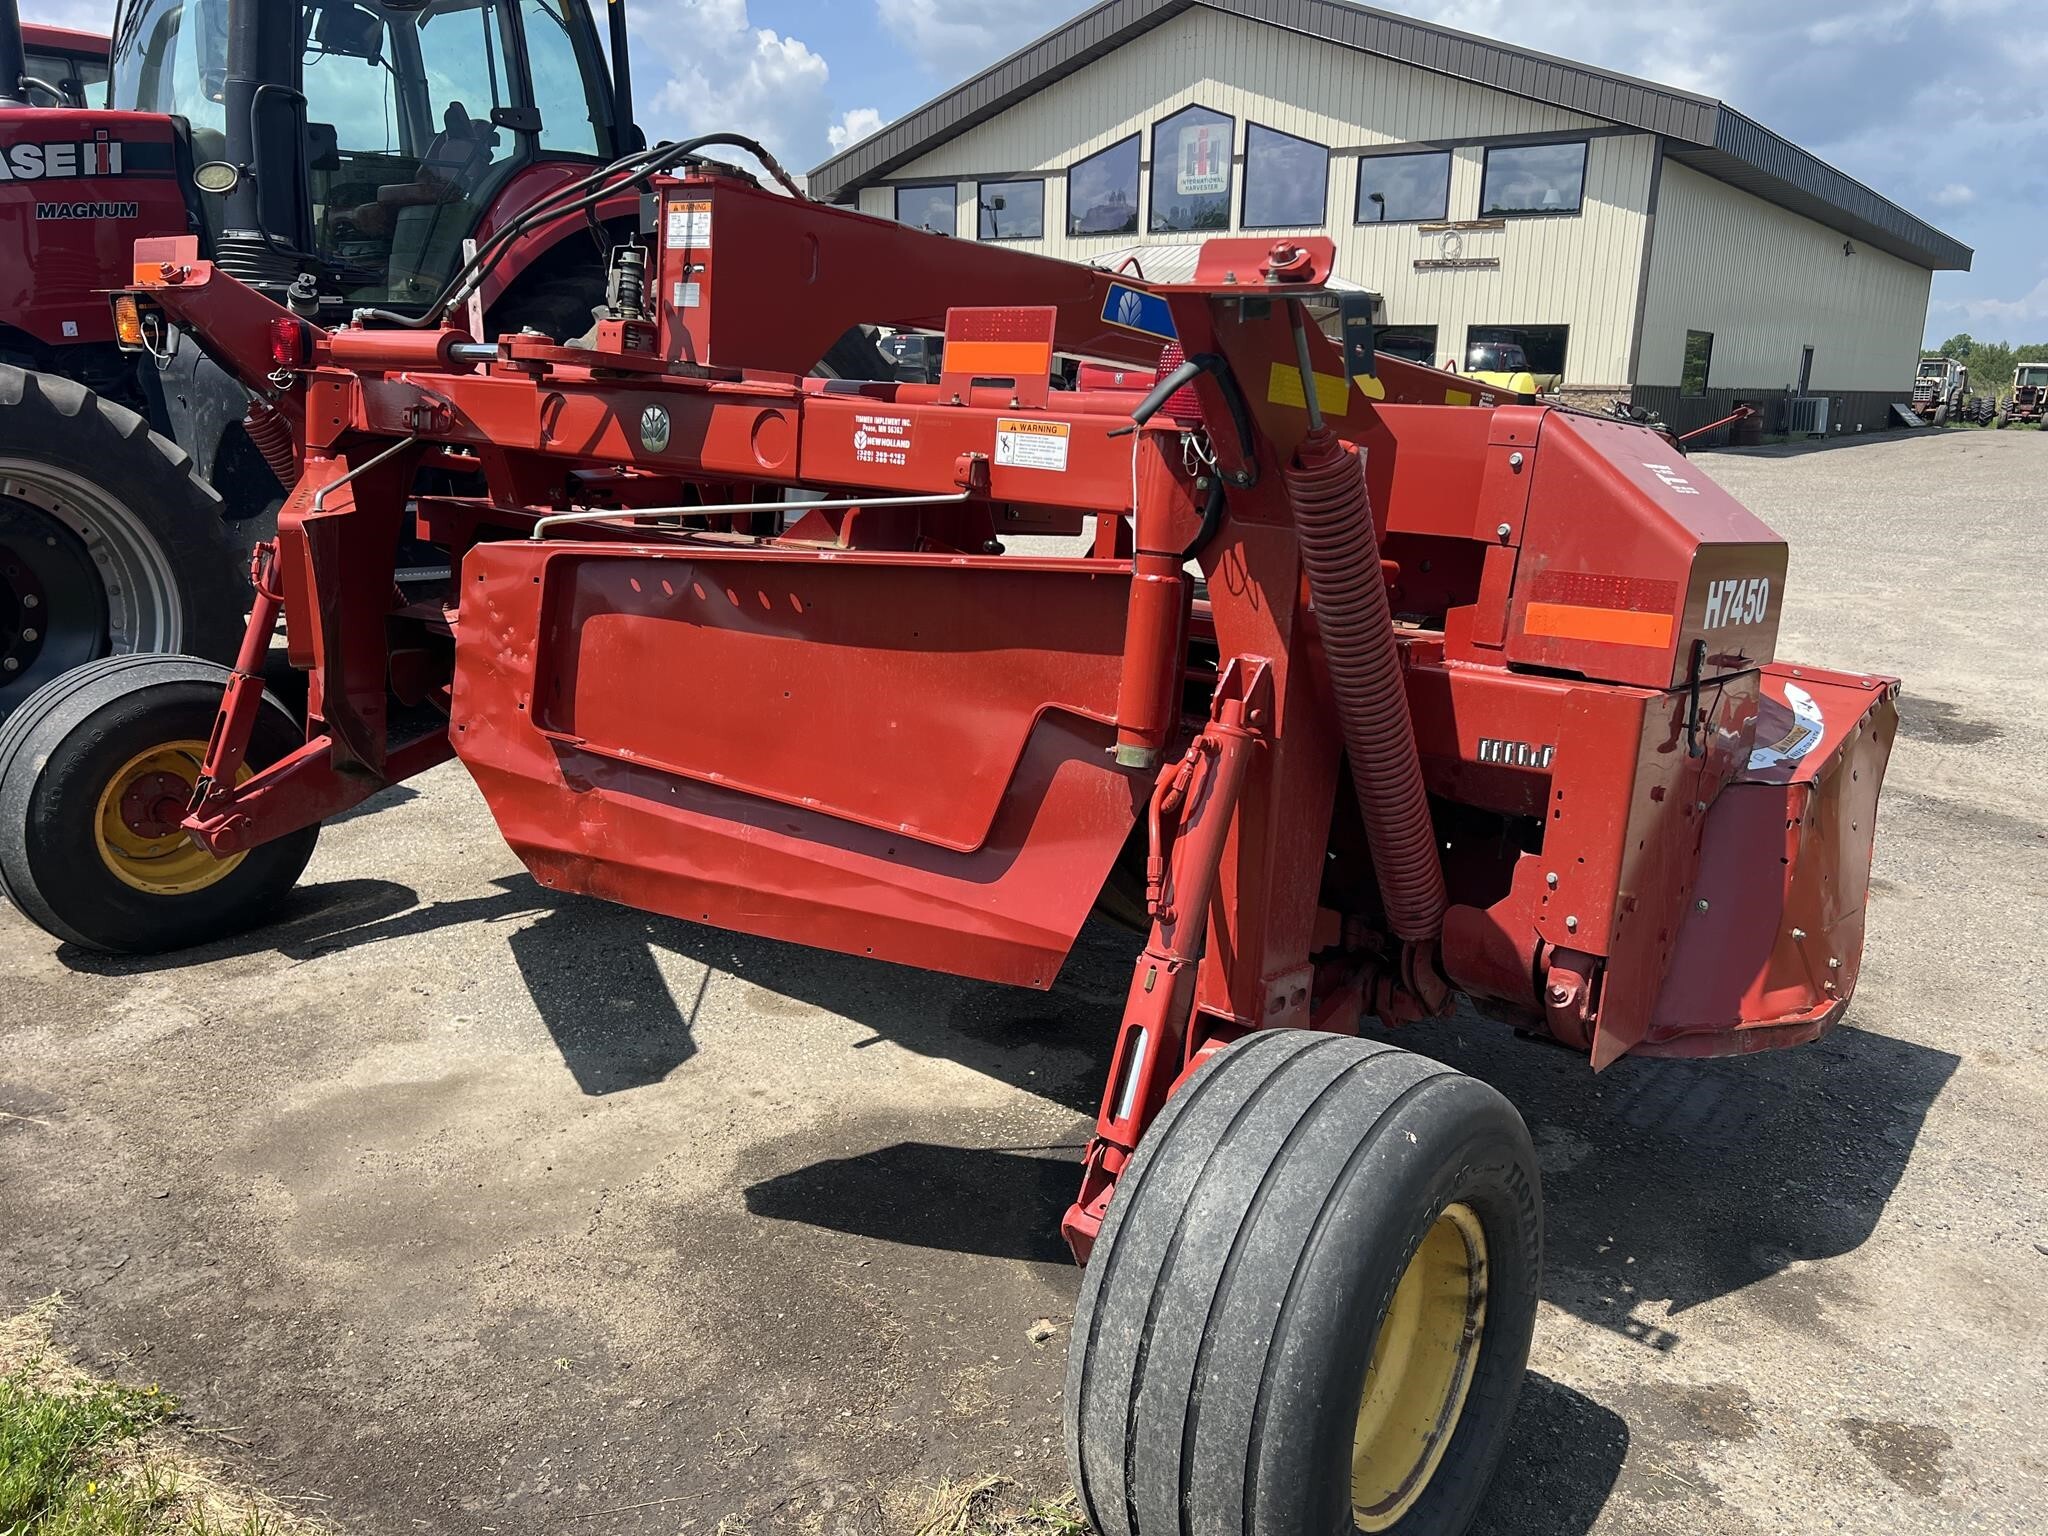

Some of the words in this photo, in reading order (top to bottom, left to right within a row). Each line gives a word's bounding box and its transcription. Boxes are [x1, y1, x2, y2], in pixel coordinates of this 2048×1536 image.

[1182, 177, 1224, 186] INTERNATIONAL
[1185, 184, 1219, 192] HARVESTER
[36, 202, 139, 220] MAGNUM
[680, 203, 707, 211] WARNING
[873, 416, 901, 426] IMPLEMENT
[1019, 423, 1058, 434] WARNING
[1703, 577, 1769, 630] H7450
